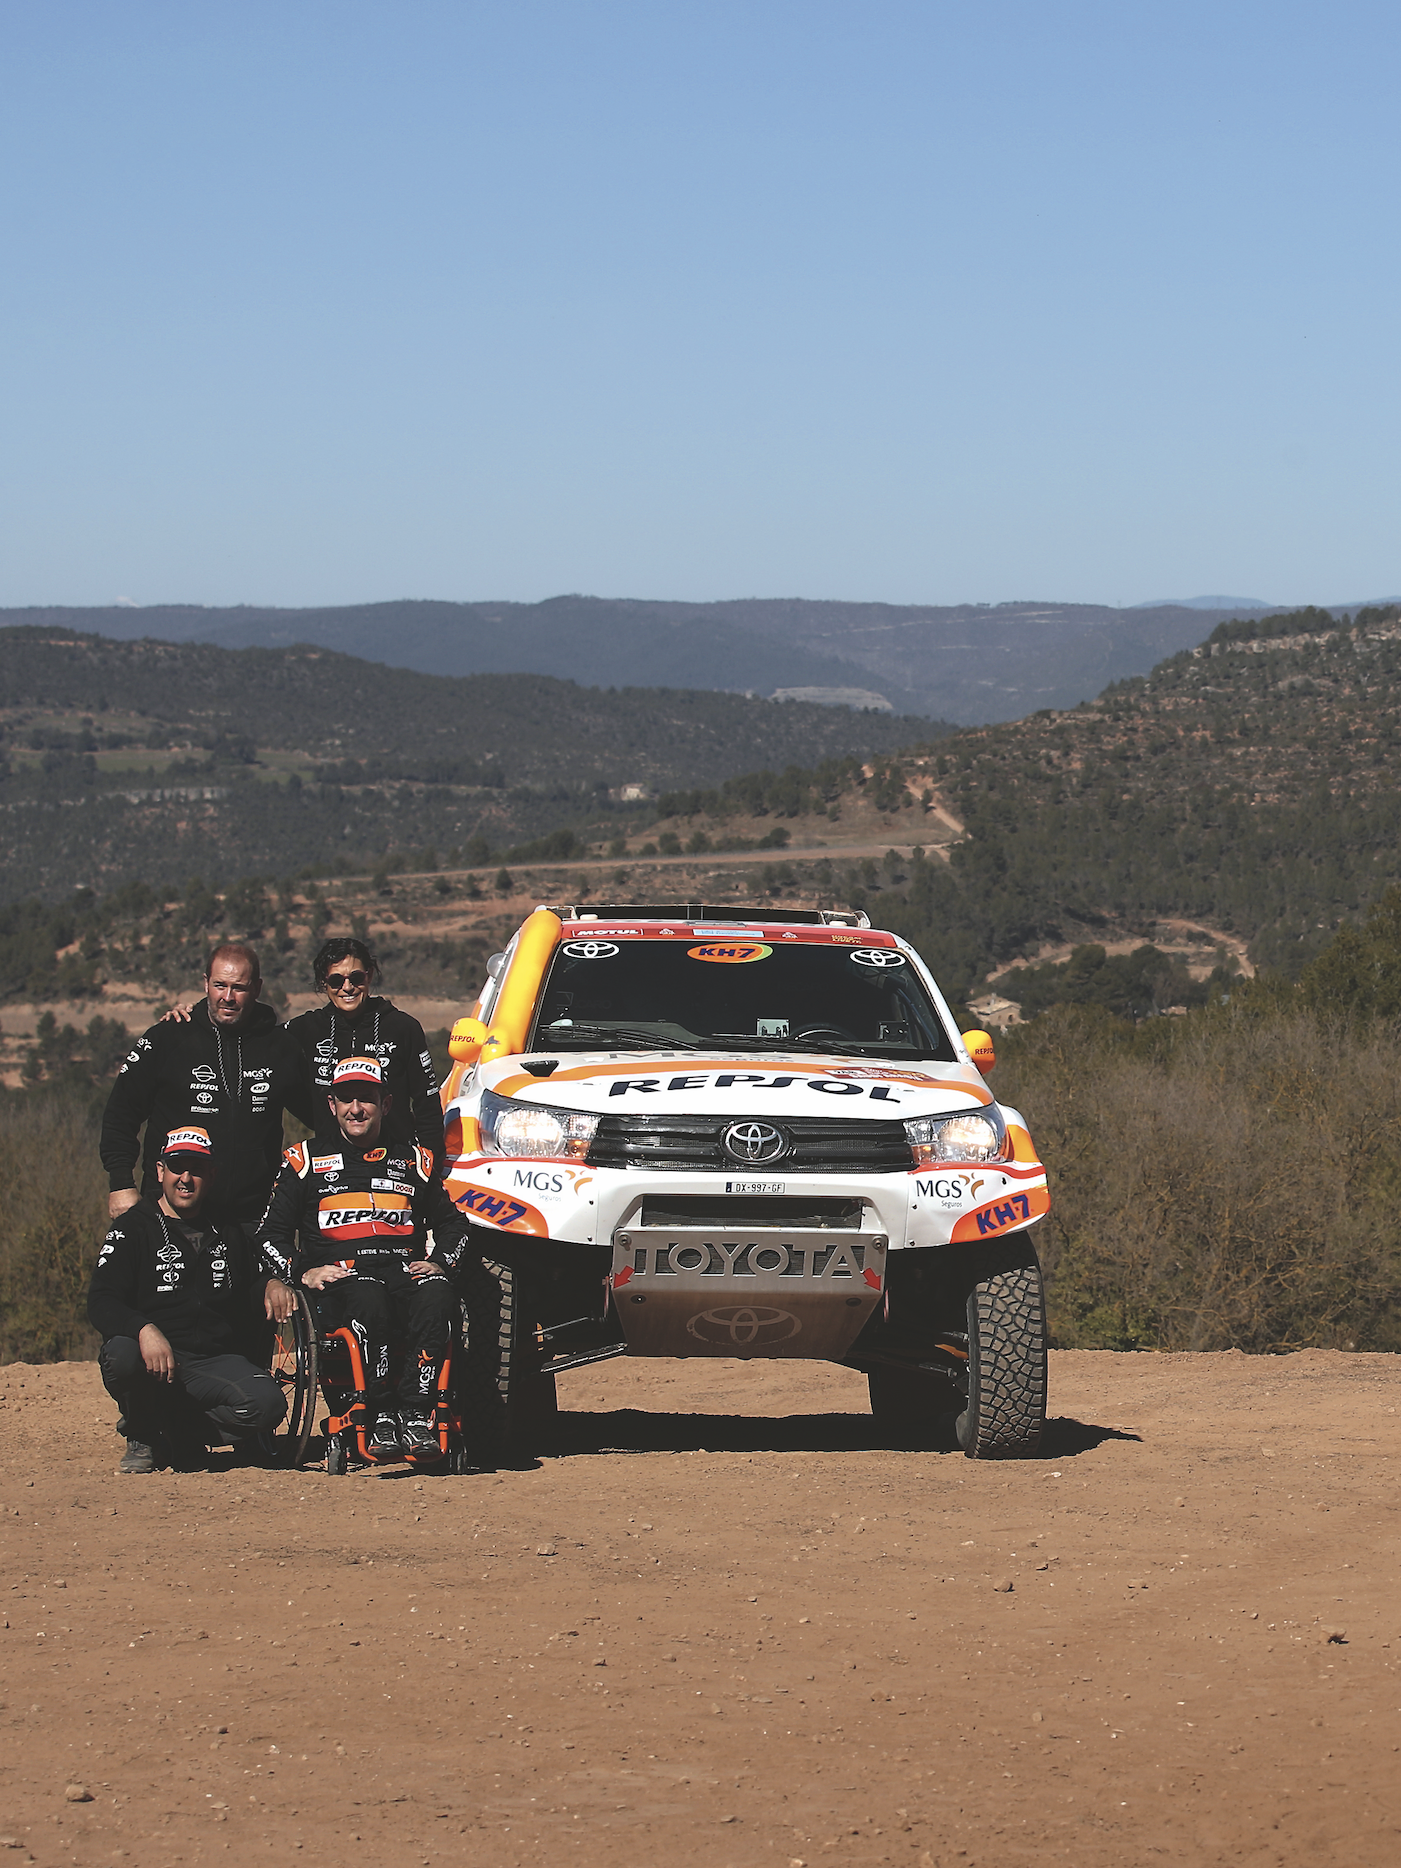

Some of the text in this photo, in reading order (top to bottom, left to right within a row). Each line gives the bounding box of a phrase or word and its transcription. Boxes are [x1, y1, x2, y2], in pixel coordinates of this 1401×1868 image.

[450, 1034, 476, 1043] REPSOL
[243, 1070, 263, 1078] MGS
[337, 1063, 378, 1075] REPSOL
[190, 1083, 219, 1091] REPSOL
[608, 1074, 901, 1104] REPSOL
[169, 1133, 209, 1146] REPSOL
[314, 1159, 341, 1168] REPSOL
[387, 1159, 407, 1168] MGS
[513, 1169, 564, 1193] MGS
[735, 1183, 783, 1193] DX-997-GF
[916, 1179, 962, 1199] MGS
[940, 1200, 963, 1209] Seguros
[634, 1241, 866, 1279] TOYOTA
[380, 1345, 389, 1377] MGS
[419, 1365, 432, 1395] MGS
